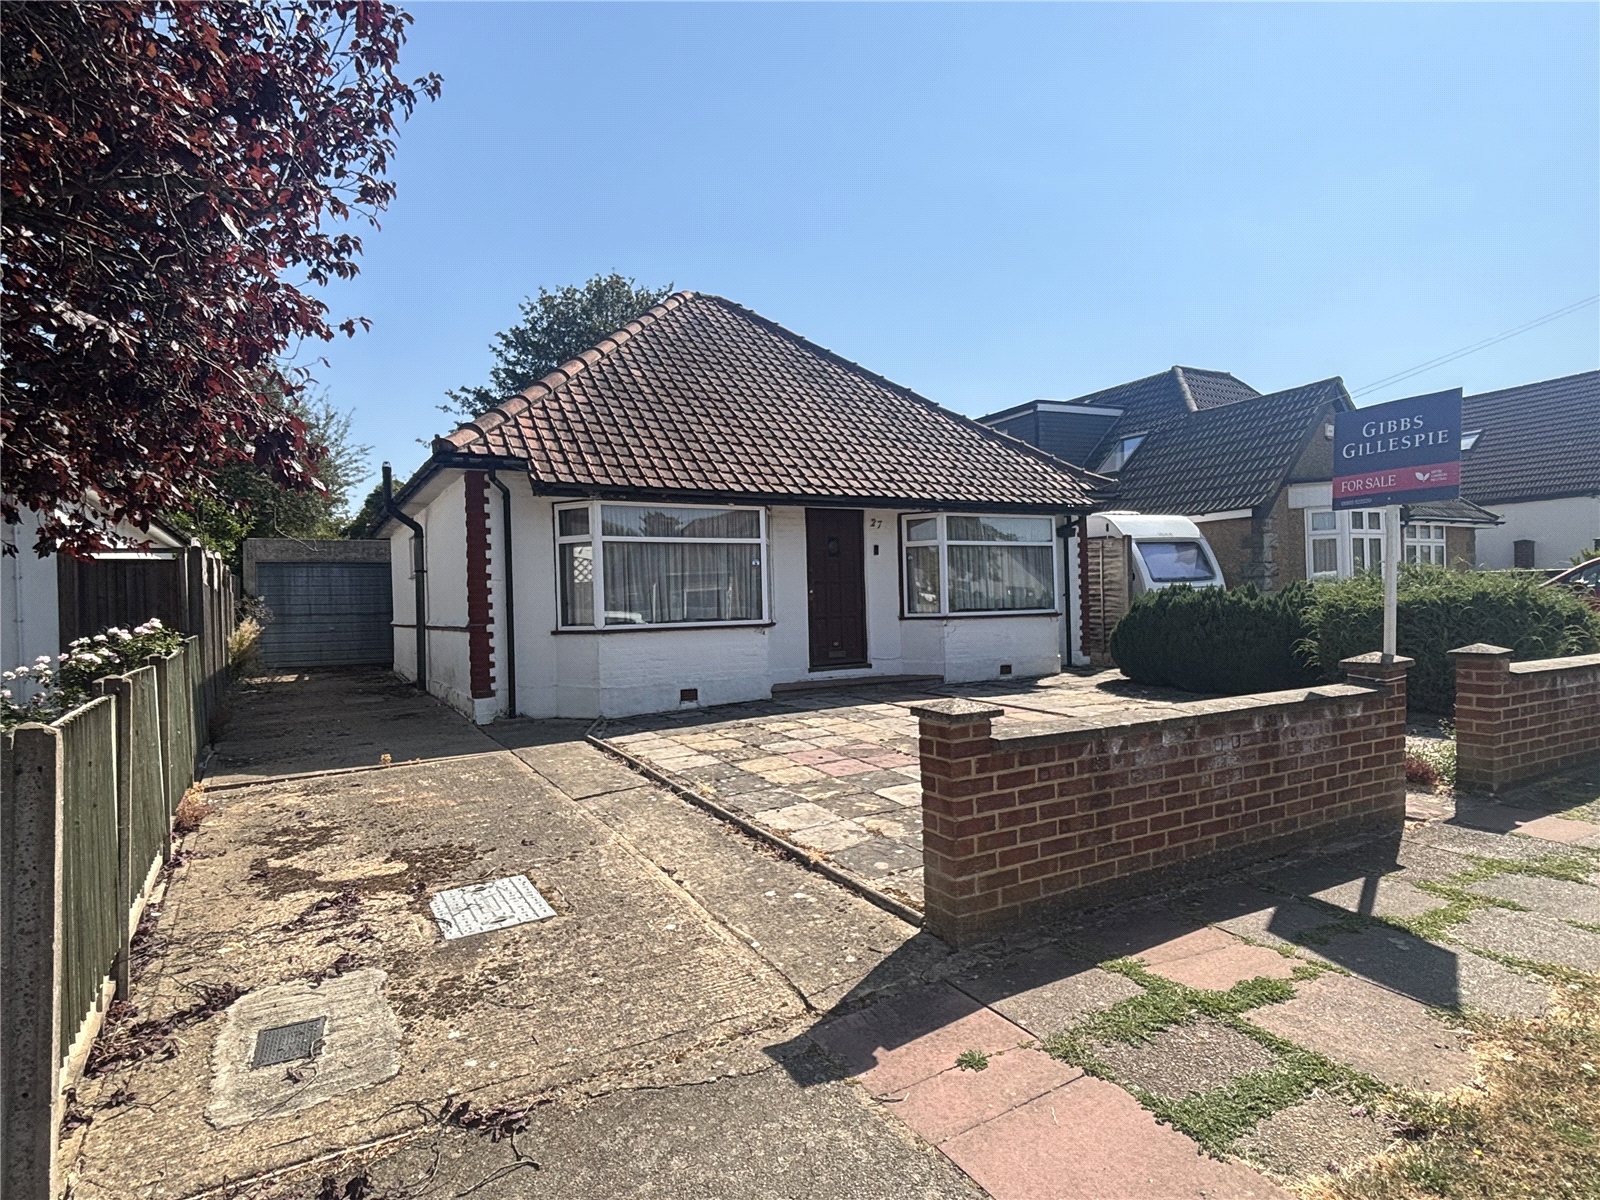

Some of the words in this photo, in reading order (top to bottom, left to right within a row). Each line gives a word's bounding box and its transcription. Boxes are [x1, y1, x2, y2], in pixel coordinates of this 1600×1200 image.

[1362, 415, 1424, 438] GIBBS
[1342, 430, 1449, 459] GILLESPIE
[1341, 478, 1363, 493] FOR
[1365, 474, 1397, 490] SALE
[870, 518, 883, 529] 27
